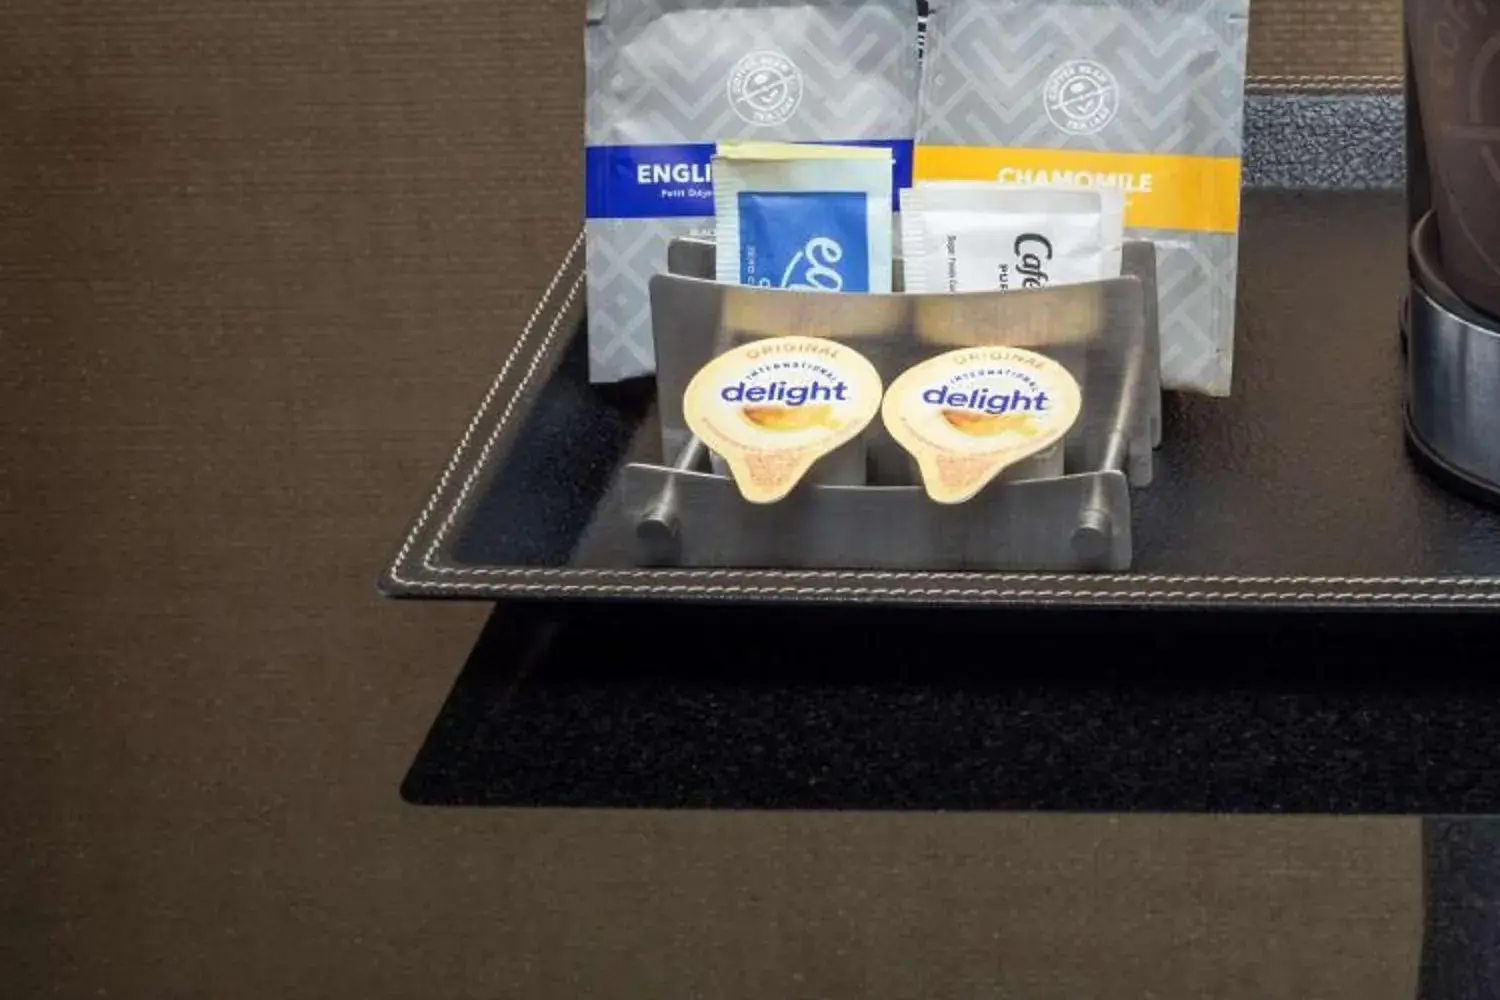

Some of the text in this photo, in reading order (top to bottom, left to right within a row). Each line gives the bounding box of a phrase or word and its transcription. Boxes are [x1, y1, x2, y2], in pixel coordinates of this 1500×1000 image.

[637, 163, 712, 184] ENGLI
[998, 167, 1153, 193] CHAMOMILE
[721, 381, 849, 407] delight
[923, 385, 1049, 415] delight
